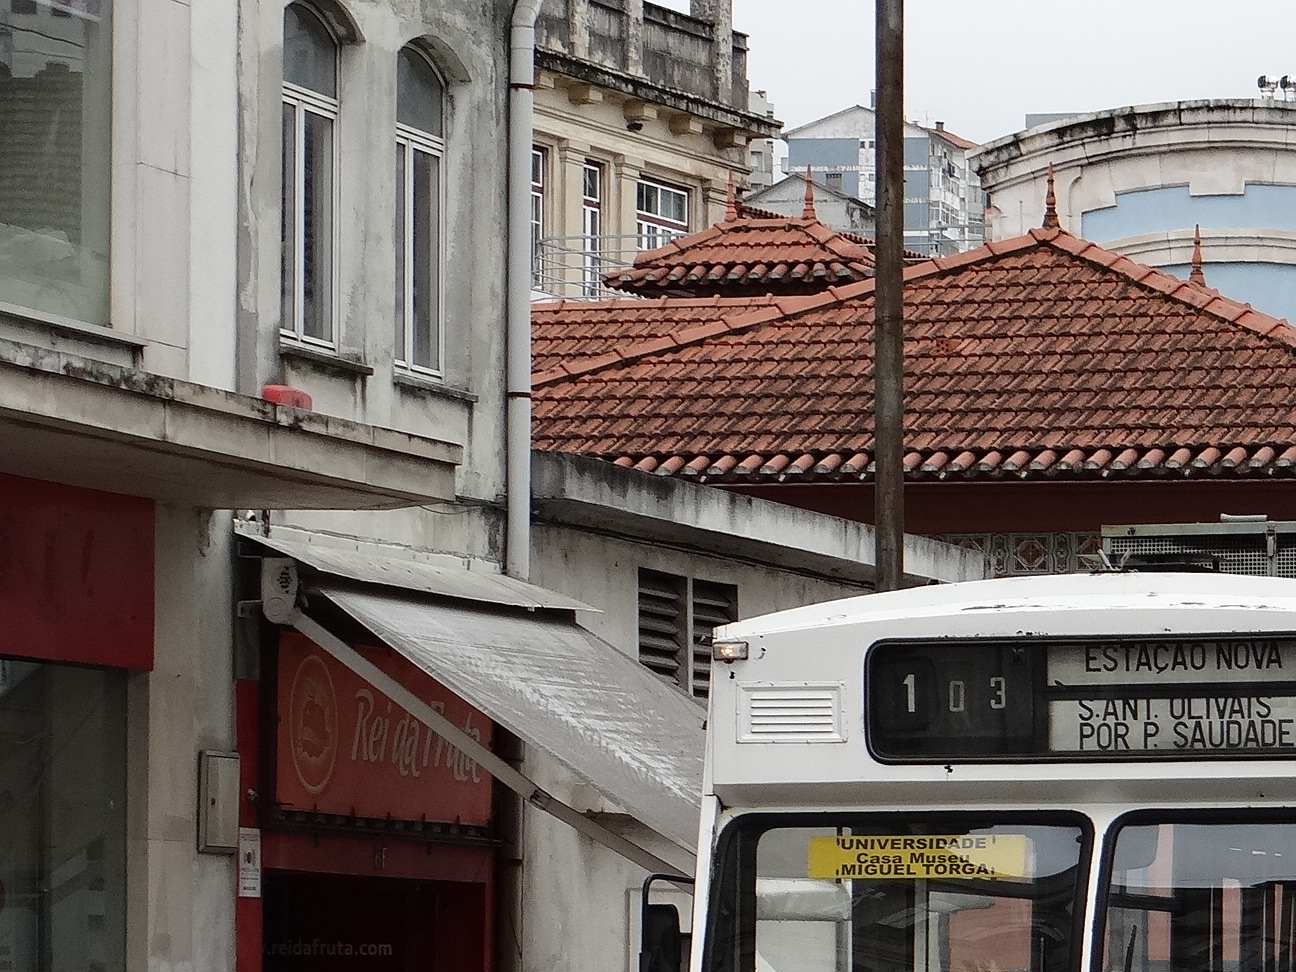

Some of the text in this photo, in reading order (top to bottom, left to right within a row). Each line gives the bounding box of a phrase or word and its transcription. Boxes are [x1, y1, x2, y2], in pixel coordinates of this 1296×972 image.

[1215, 641, 1282, 670] NOVA
[351, 688, 392, 763] Rei
[391, 711, 421, 778] da
[1079, 718, 1295, 750] POR P. SAUDADE
[841, 837, 987, 850] UNIVERSIDADE
[856, 852, 970, 864] Casa Museu
[841, 863, 989, 876] MIGUEL TORGA
